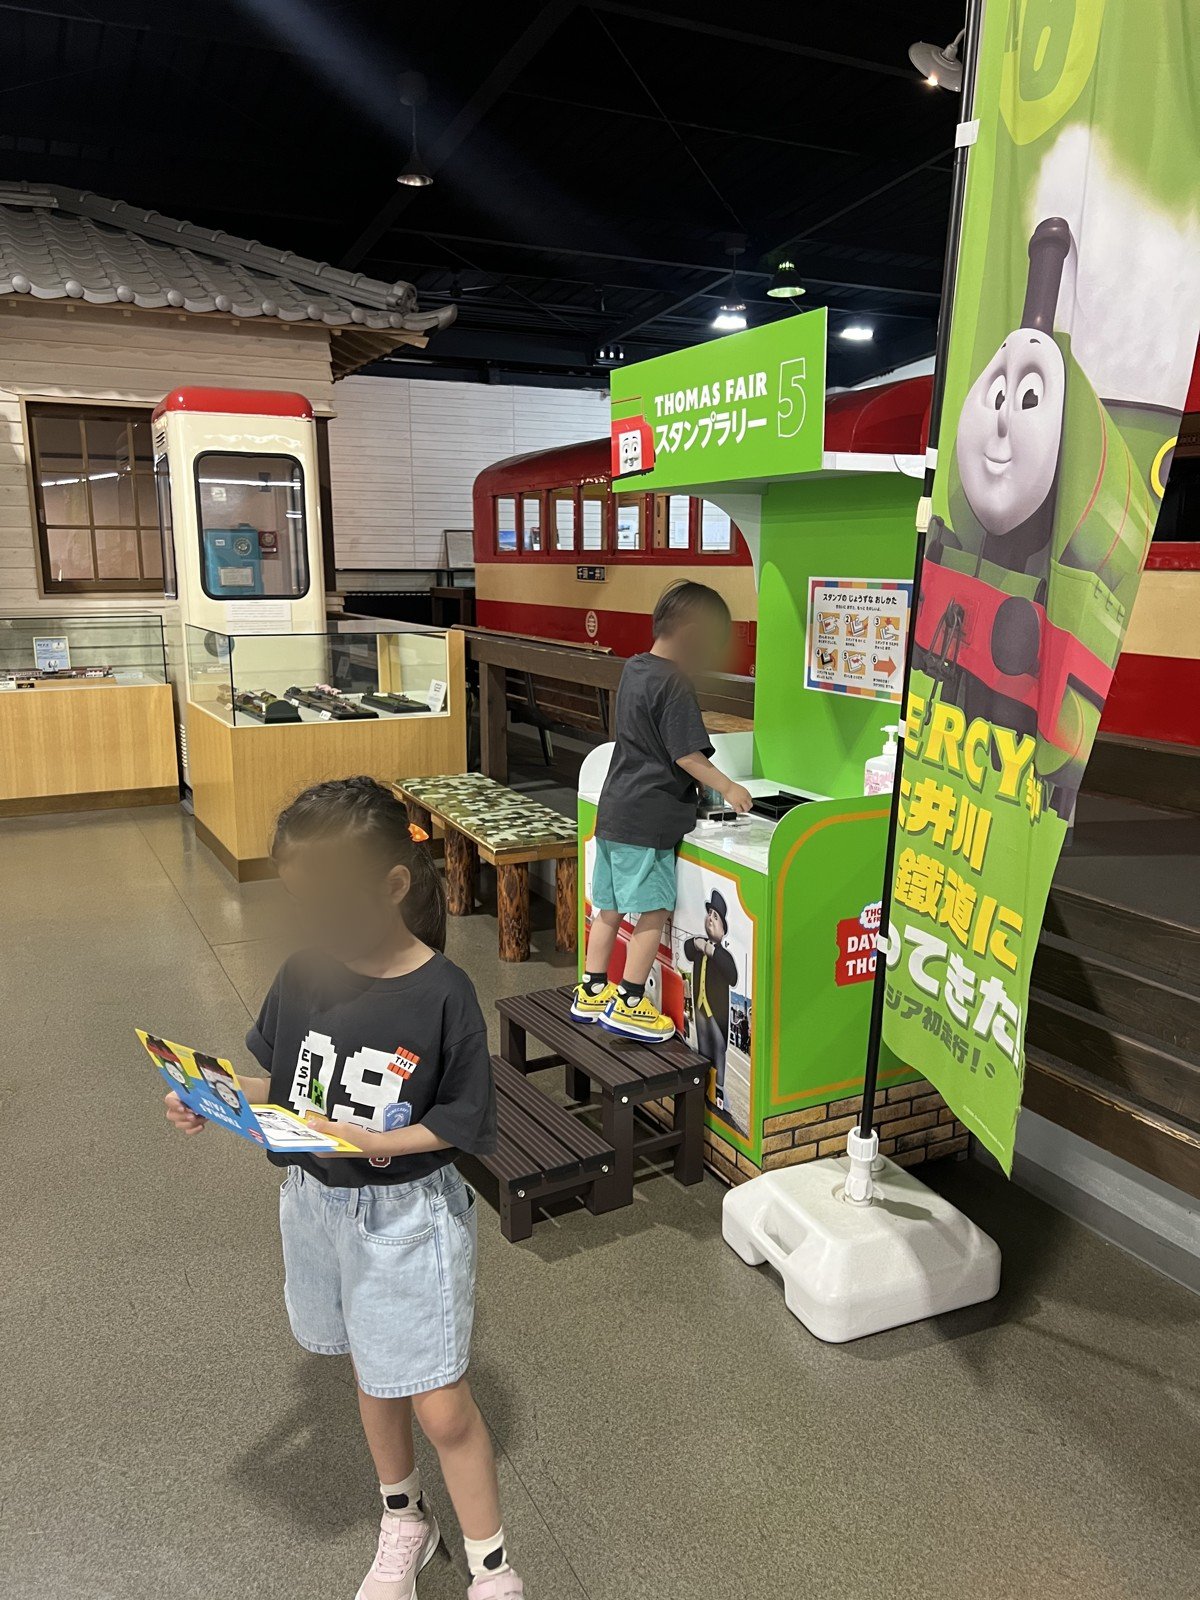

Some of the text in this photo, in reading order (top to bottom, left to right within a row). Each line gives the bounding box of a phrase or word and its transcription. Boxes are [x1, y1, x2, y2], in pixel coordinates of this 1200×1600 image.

[654, 371, 768, 418] THOMAS FAIR
[777, 357, 807, 438] 5
[654, 407, 768, 456] スタンプラリー
[822, 593, 898, 605] スタンプの じょうずな おしかた
[893, 847, 1024, 971] 鐵道に
[847, 933, 878, 953] DAY
[296, 1049, 310, 1098] EST.
[395, 1056, 413, 1070] TNT
[386, 1106, 409, 1118] MINECRAFT
